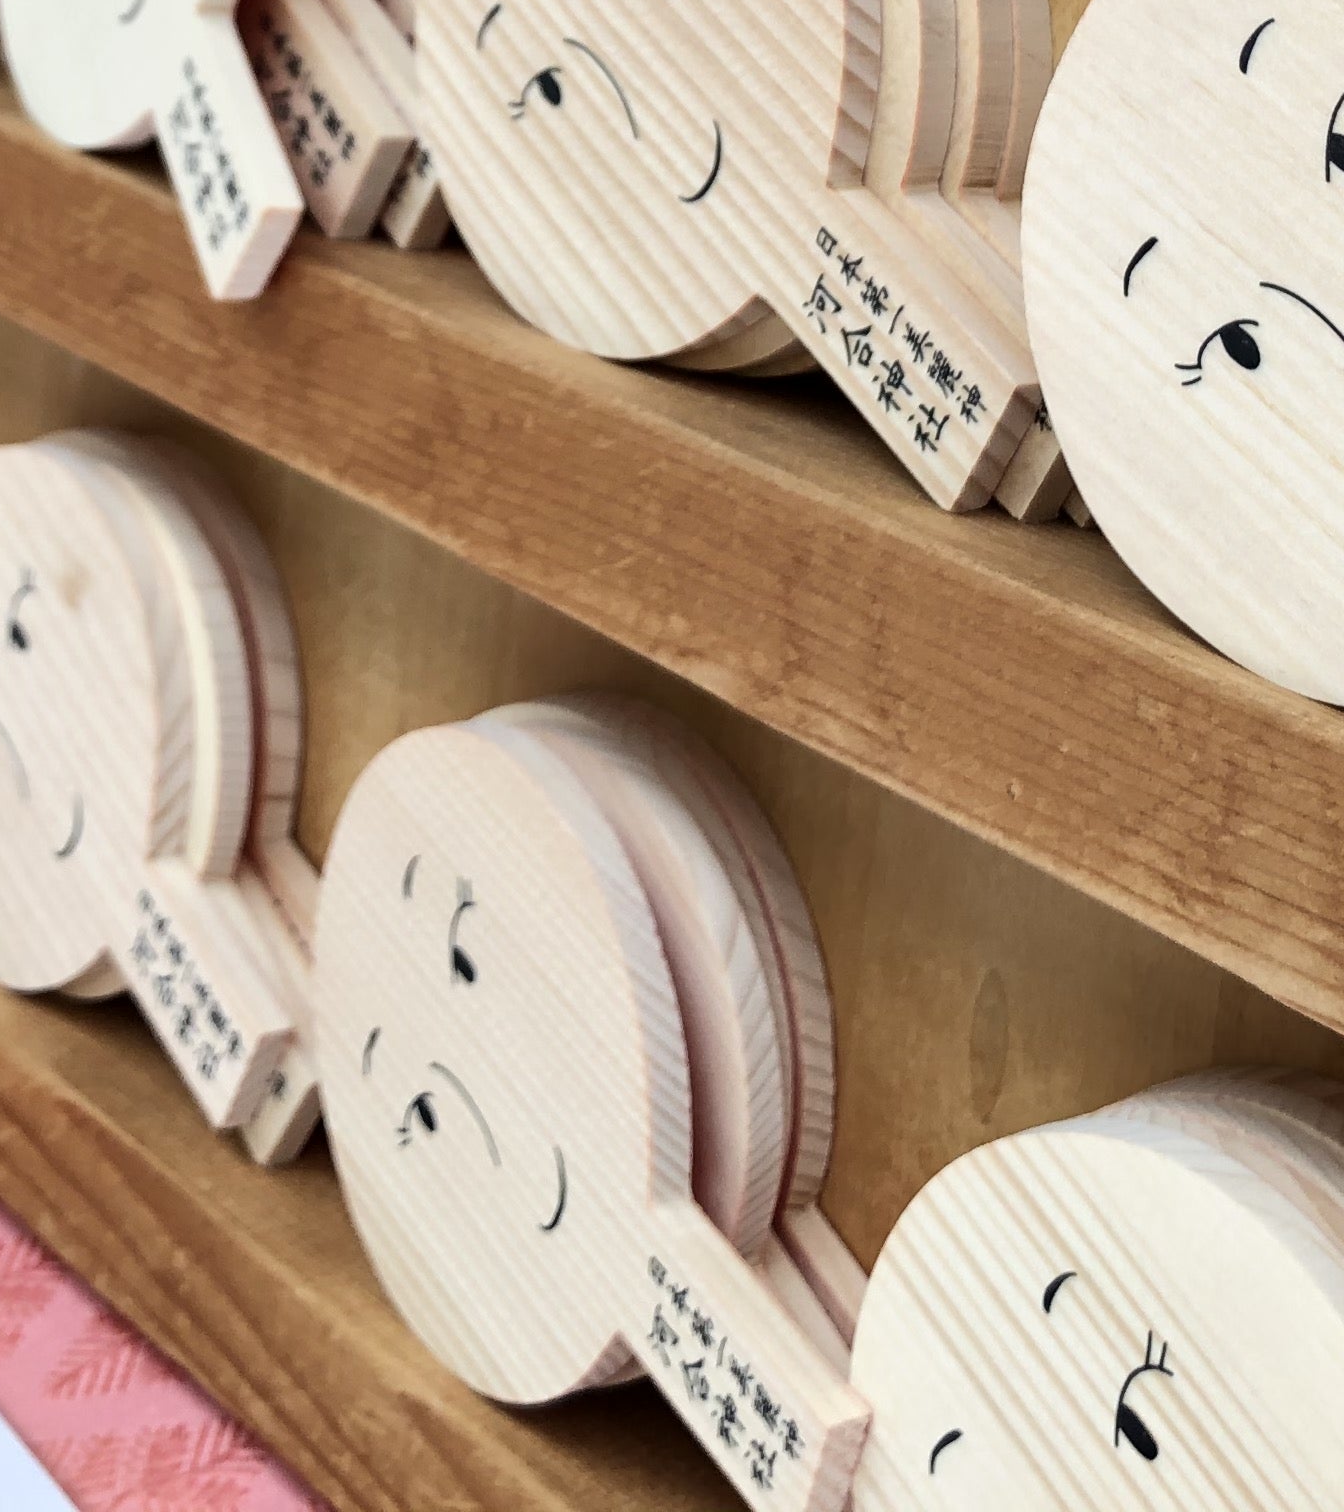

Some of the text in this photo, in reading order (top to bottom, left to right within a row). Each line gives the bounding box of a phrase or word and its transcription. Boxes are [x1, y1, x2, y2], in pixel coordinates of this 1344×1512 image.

[802, 273, 951, 453] 河合神社
[815, 225, 989, 424] 日本第一美麗神
